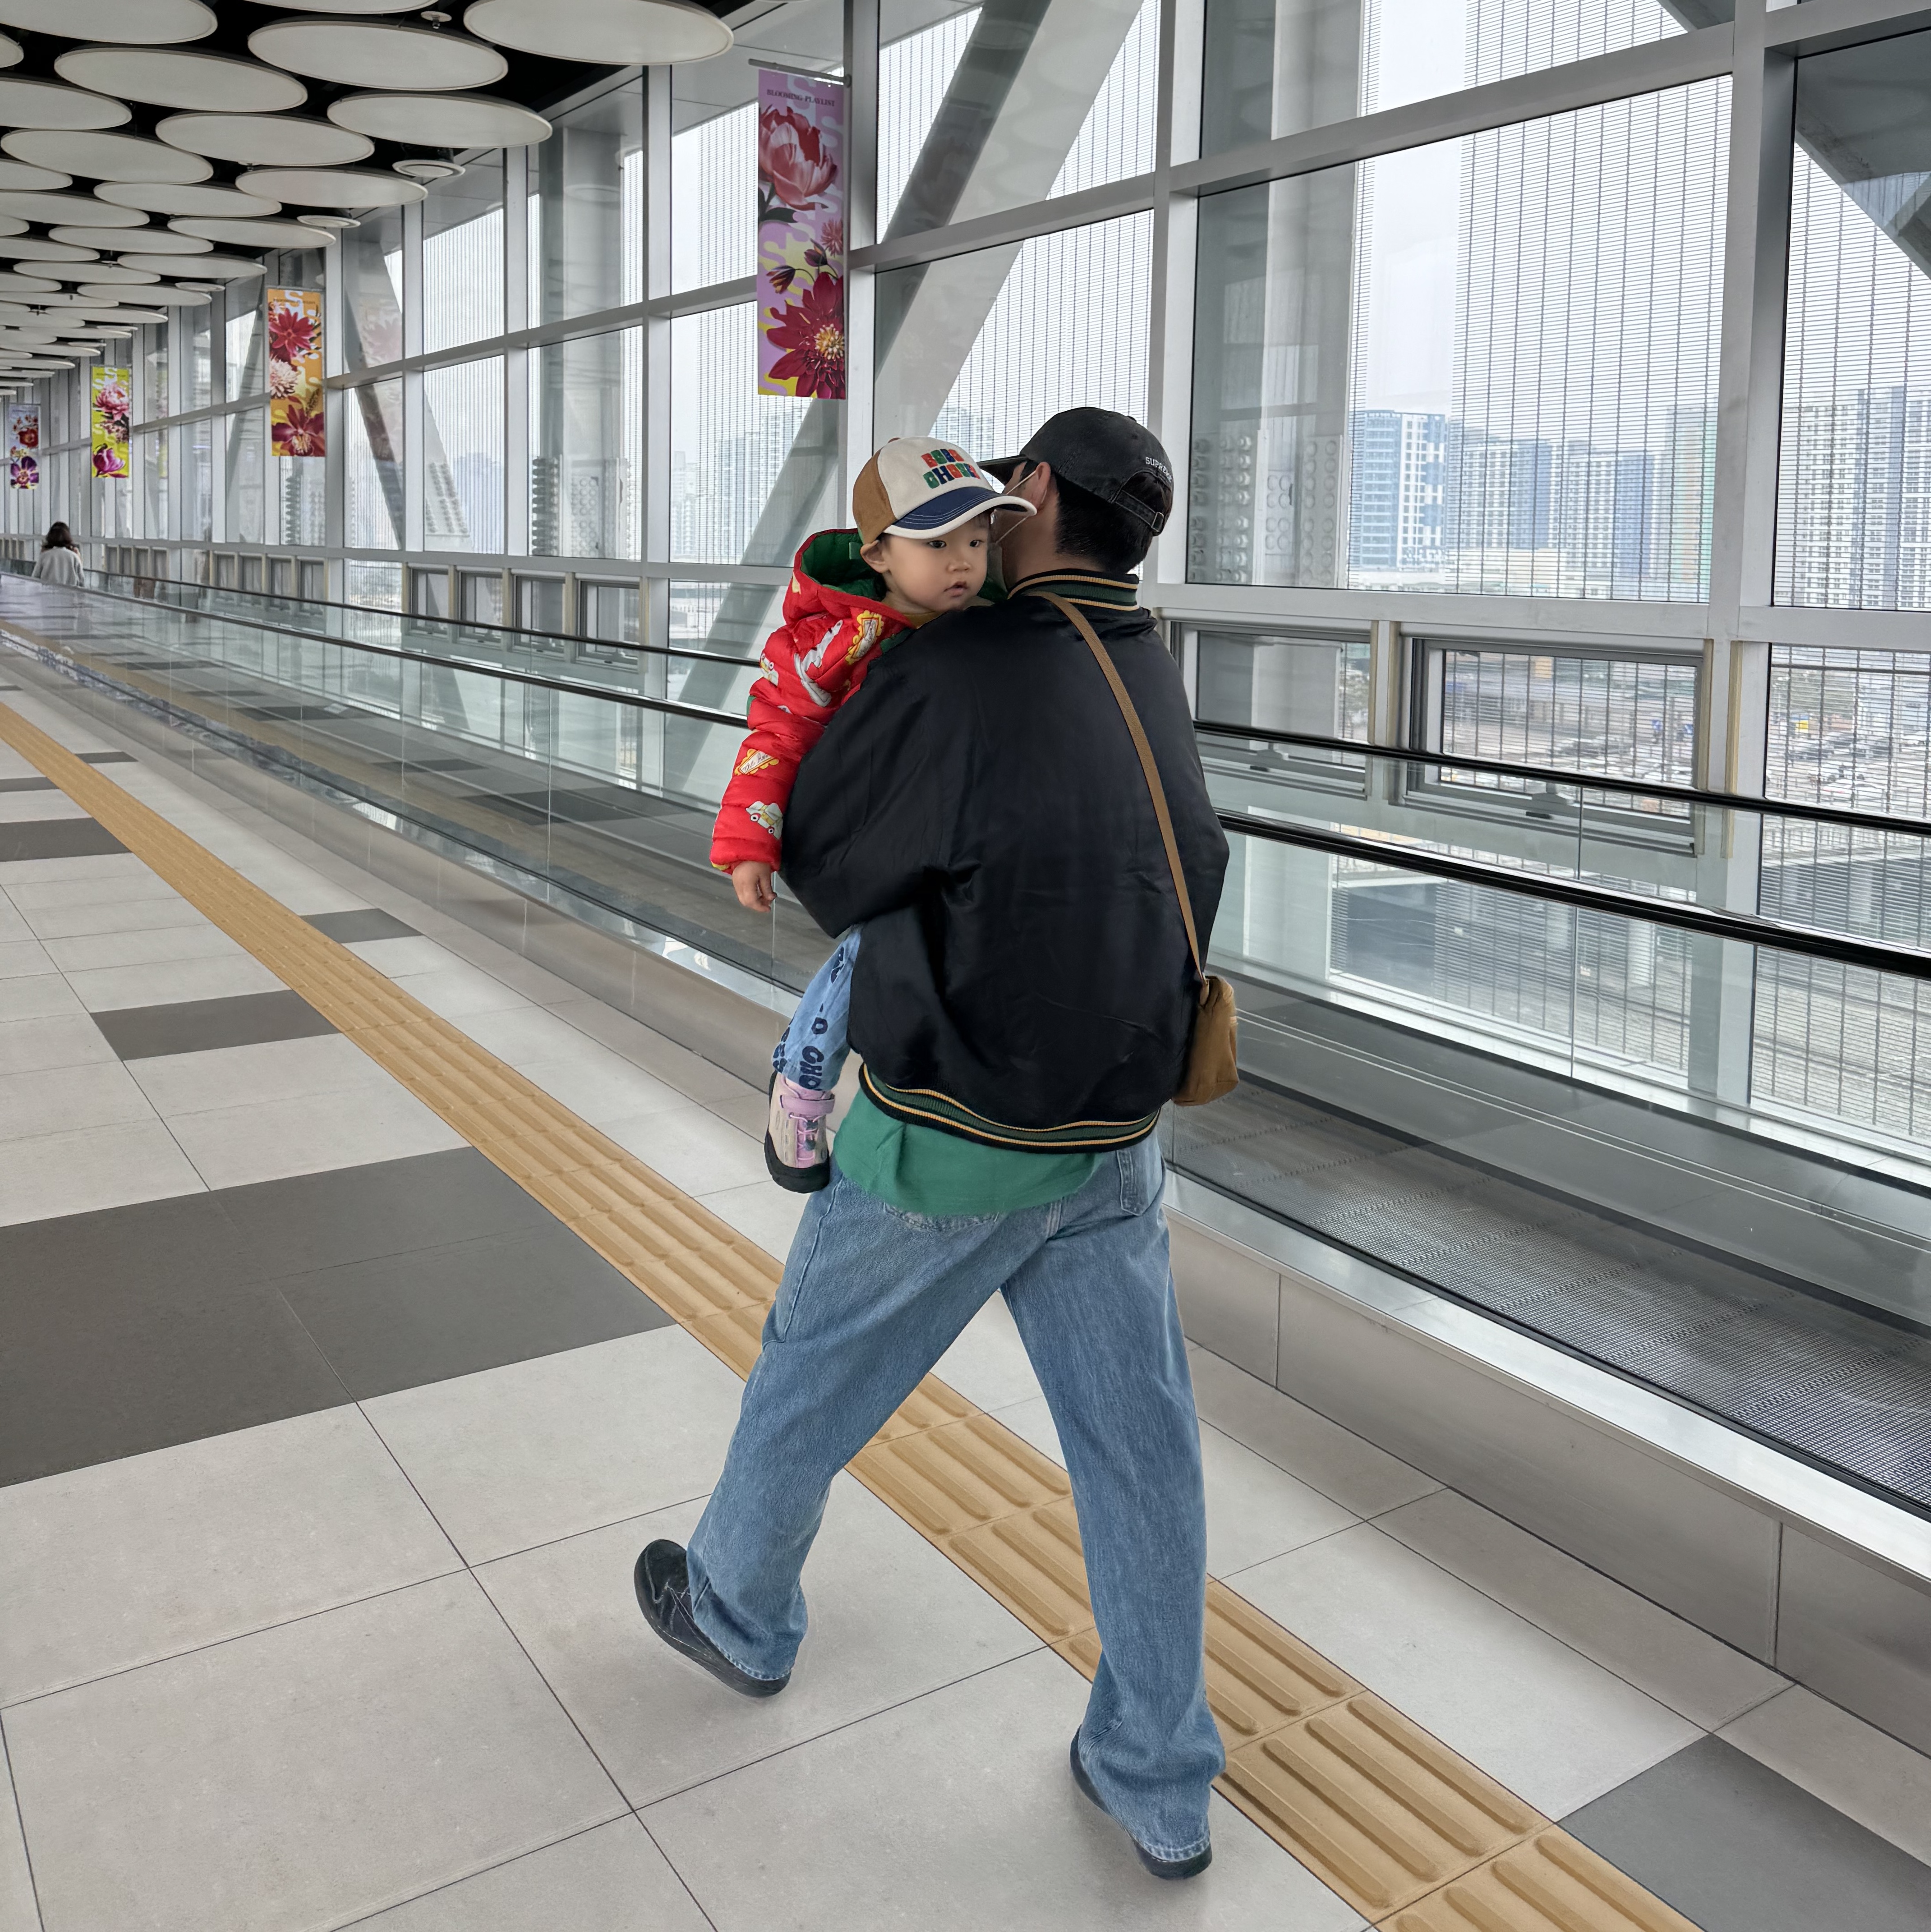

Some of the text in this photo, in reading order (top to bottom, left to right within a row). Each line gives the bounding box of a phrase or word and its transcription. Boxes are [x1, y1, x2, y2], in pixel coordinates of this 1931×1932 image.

[767, 89, 835, 106] BLOOMING PLAYLIST
[799, 1046, 824, 1091] CHO
